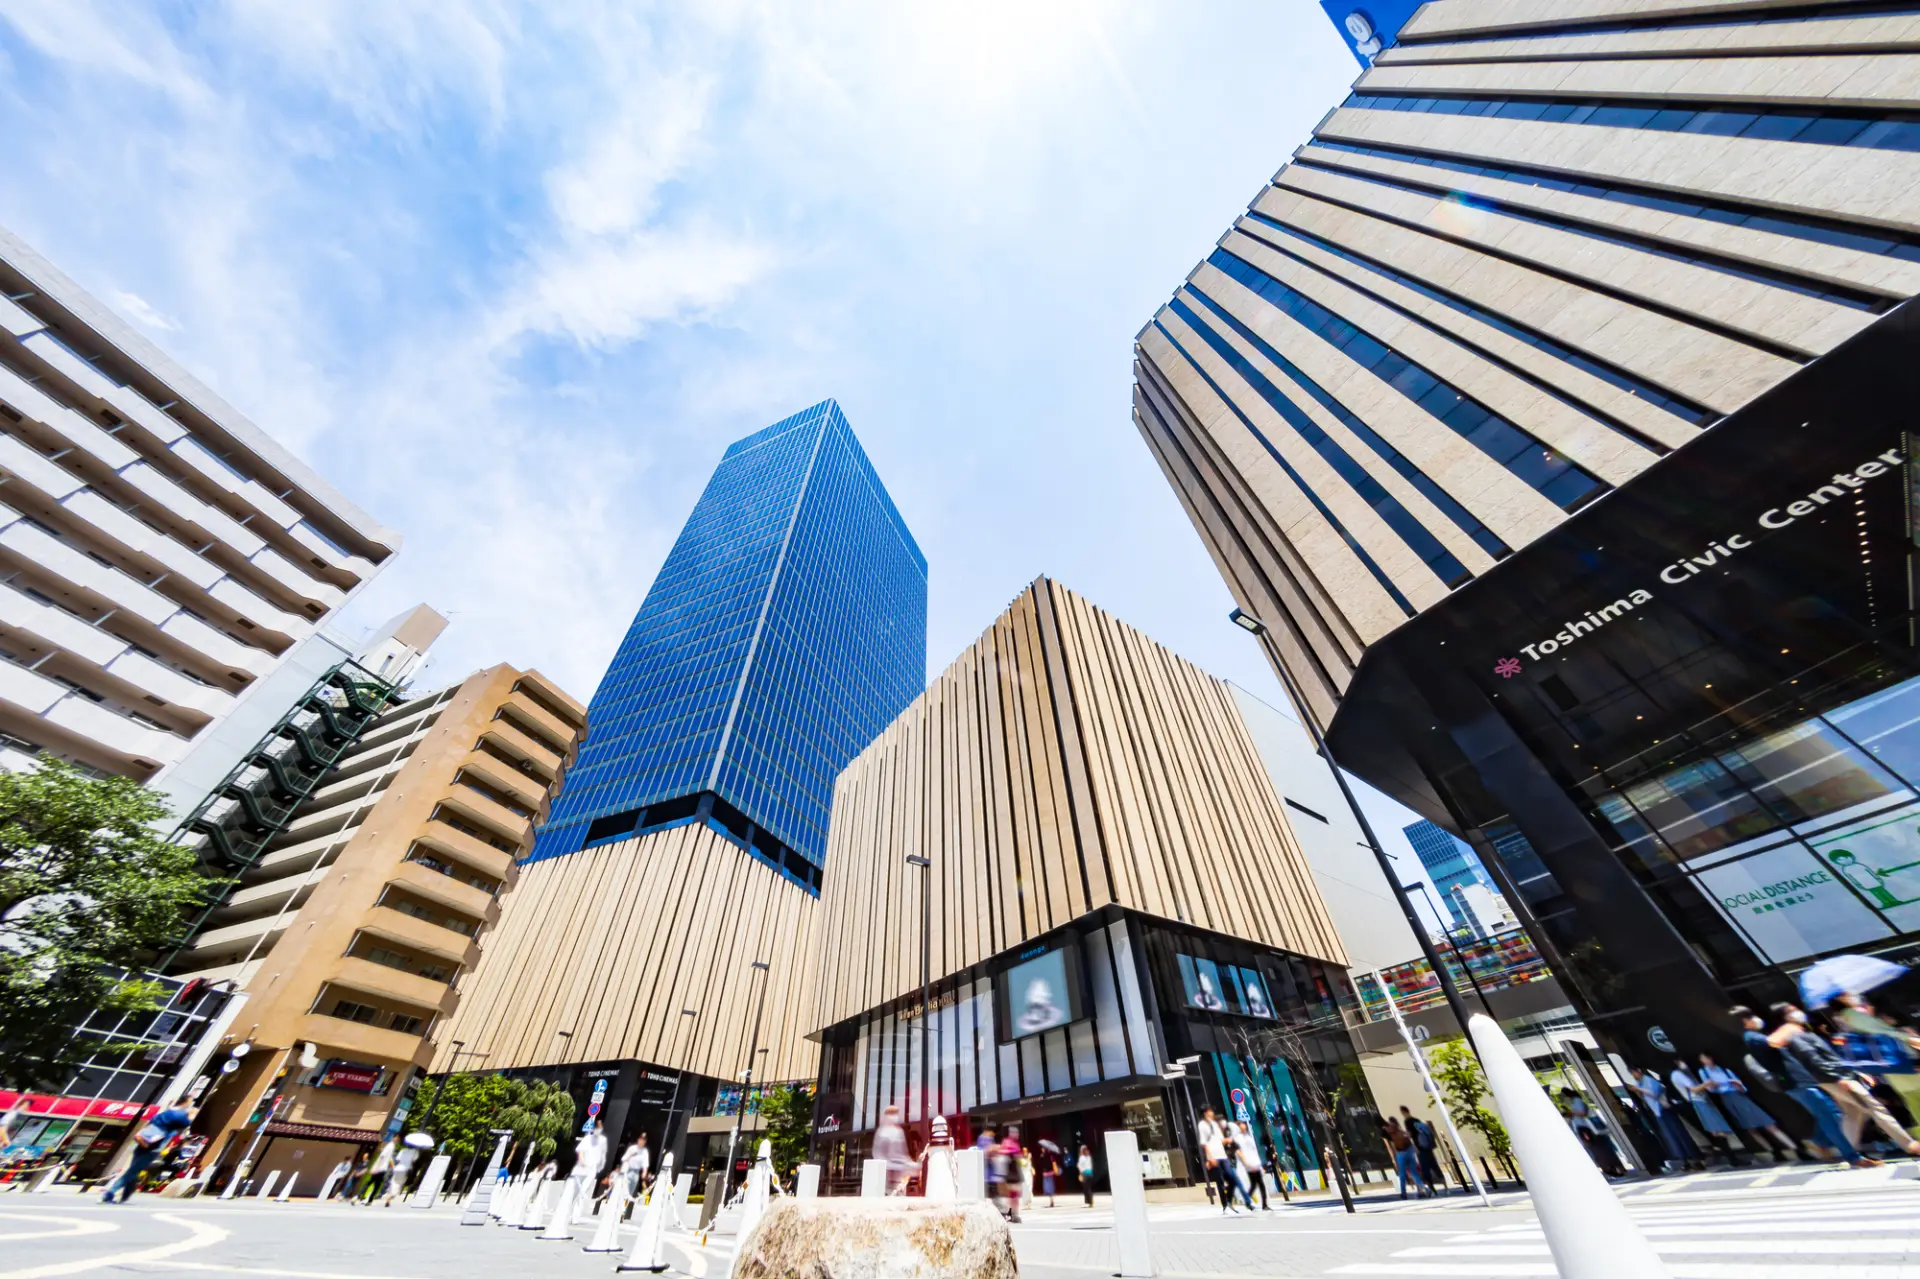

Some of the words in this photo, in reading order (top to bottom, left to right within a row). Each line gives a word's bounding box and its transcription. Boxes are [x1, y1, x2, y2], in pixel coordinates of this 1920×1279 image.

[1519, 587, 1653, 662] Toshima
[1659, 531, 1753, 585] Civic
[1758, 447, 1905, 530] Center
[1763, 870, 1831, 897] DISTANCE
[647, 1072, 659, 1081] TOHO
[659, 1075, 678, 1084] CINEMAS
